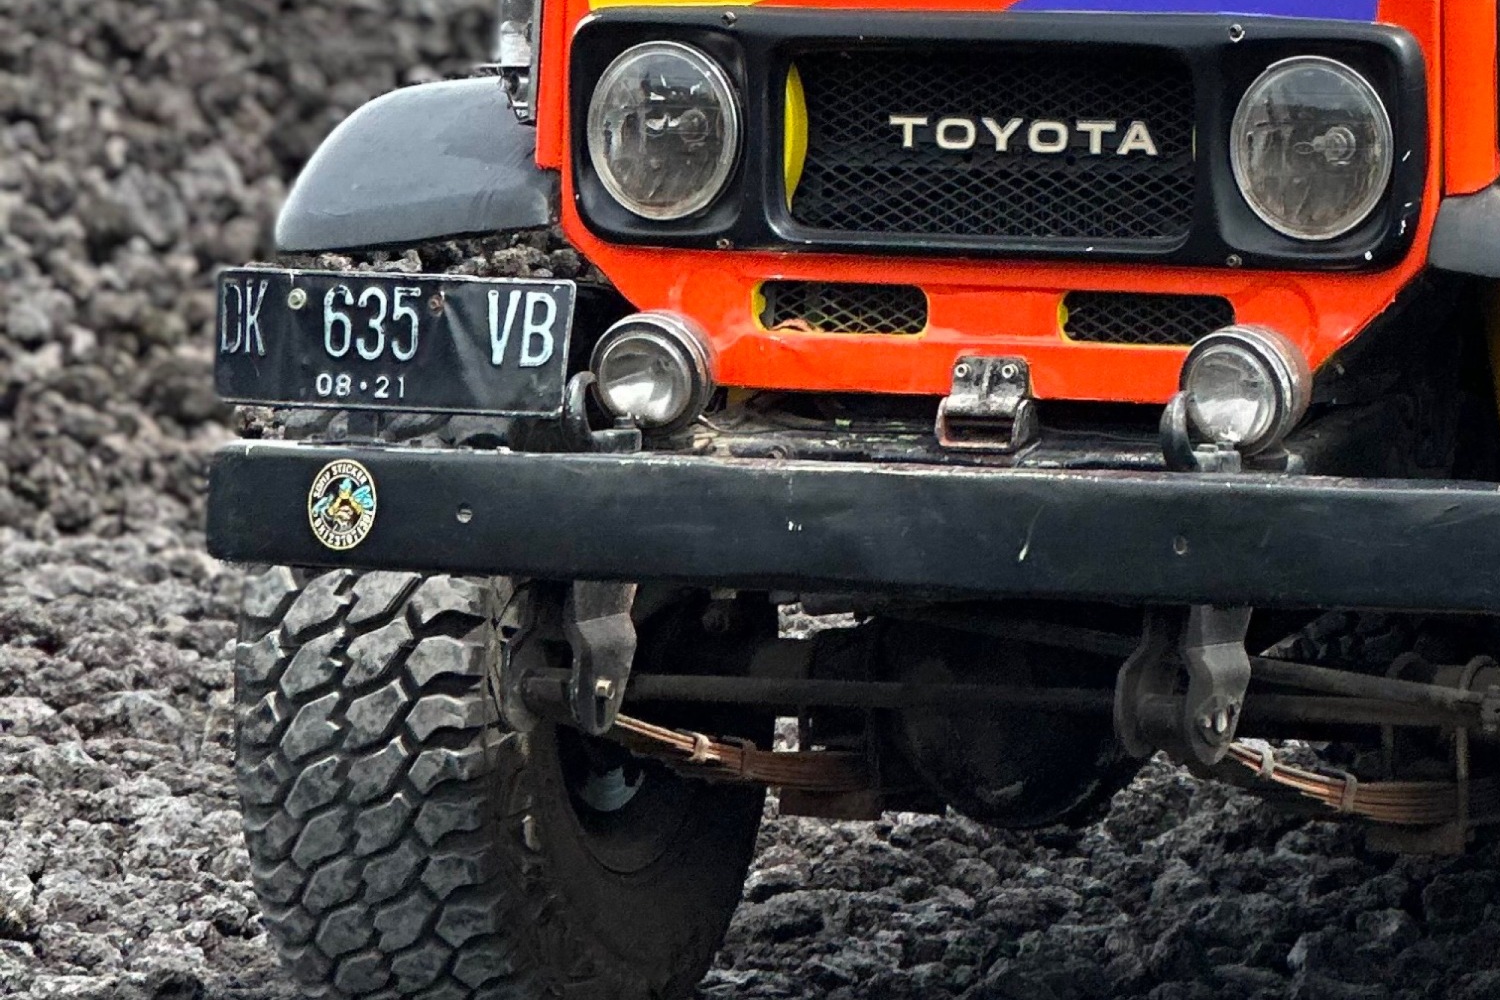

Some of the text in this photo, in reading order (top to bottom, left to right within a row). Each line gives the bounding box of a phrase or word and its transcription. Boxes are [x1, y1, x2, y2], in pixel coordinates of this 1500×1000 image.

[889, 115, 1158, 156] TOYOTA
[220, 279, 558, 368] DK 635 VB
